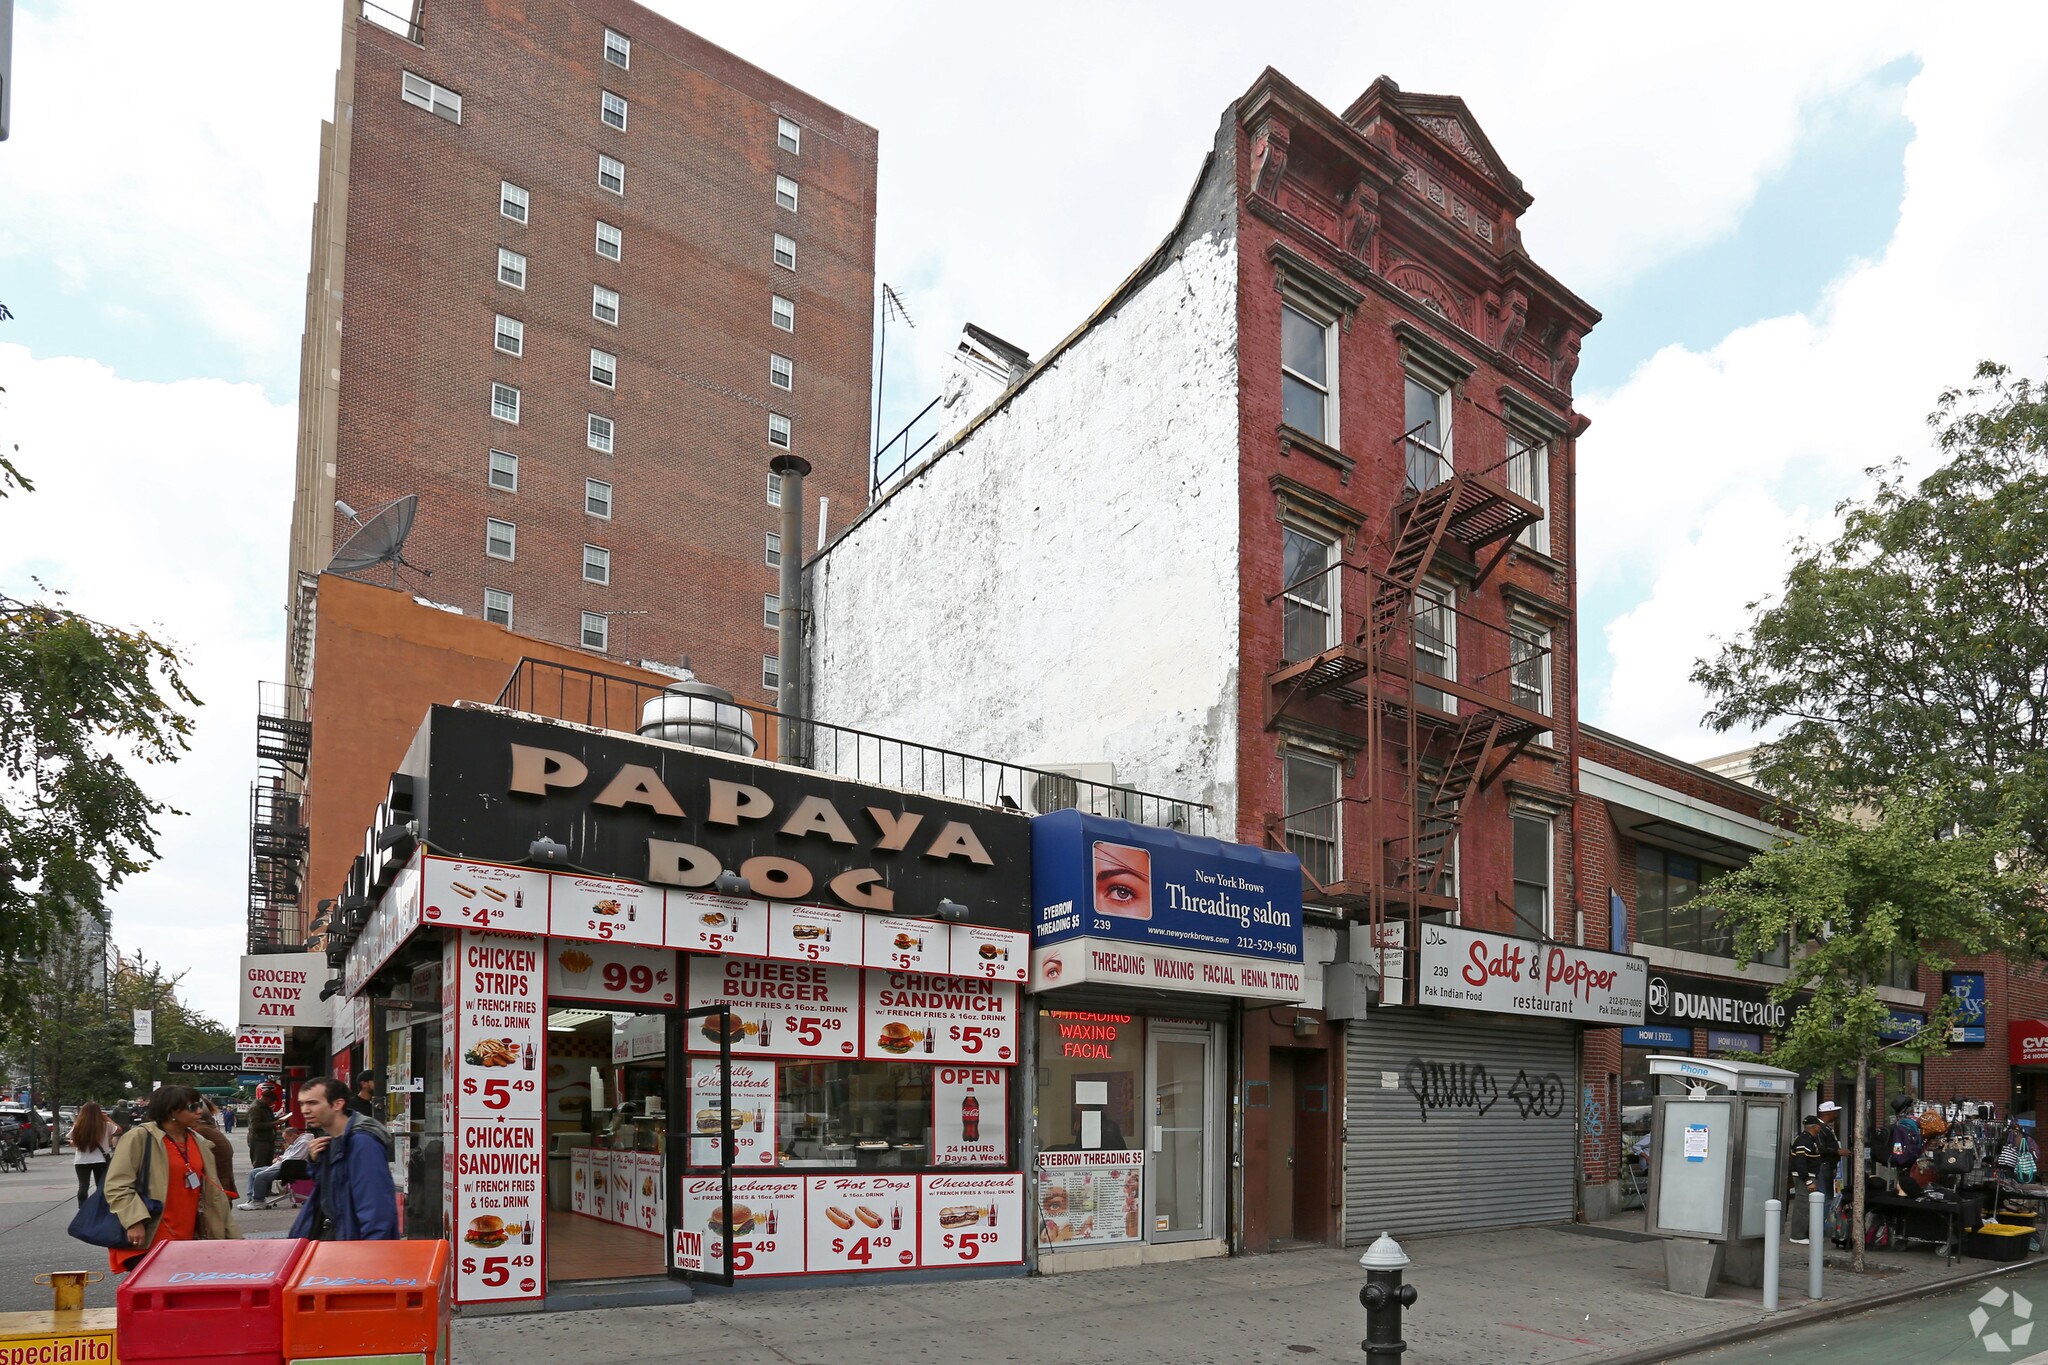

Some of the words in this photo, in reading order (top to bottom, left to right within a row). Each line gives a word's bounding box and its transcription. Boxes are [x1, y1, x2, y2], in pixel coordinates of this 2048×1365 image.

[509, 743, 994, 865] PAPAYA
[467, 866, 489, 875] Hot
[494, 869, 521, 880] Dogs
[647, 838, 894, 911] DOG
[575, 879, 613, 890] Chicken
[616, 884, 645, 894] Strips
[1195, 870, 1215, 884] New
[1217, 871, 1237, 888] York
[1238, 876, 1264, 894] Brows
[686, 893, 704, 901] Fish
[708, 895, 749, 906] Sandwich
[1165, 882, 1250, 930] Threading
[1253, 901, 1291, 928] salon
[793, 907, 842, 918] Cheesesteak
[1044, 900, 1072, 920] EYEBROW
[880, 919, 904, 927] Chicken
[906, 922, 934, 930] Sandwich
[1037, 917, 1070, 936] THREADING
[1072, 914, 1080, 929] $5
[1094, 919, 1111, 930] 239
[969, 929, 1014, 940] Cheeseburger
[1147, 926, 1229, 944] www.newyorkbrows.com
[1425, 928, 1447, 946] حلال
[1237, 936, 1297, 955] 212-529-9500
[468, 946, 535, 972] CHICKEN
[725, 960, 827, 984] CHEESE
[1092, 951, 1145, 976] THREADING
[1154, 958, 1194, 981] WAXING
[1203, 964, 1235, 985] FACIAL
[1241, 969, 1268, 989] HENNA
[1271, 972, 1299, 992] TATTOO
[1434, 966, 1449, 977] 239
[1462, 940, 1525, 986] Salt
[1529, 955, 1540, 980] &
[1546, 948, 1618, 1003] Pepper
[1626, 962, 1643, 972] HALAL
[248, 969, 307, 984] GROCERY
[475, 972, 528, 996] STRIPS
[723, 979, 829, 1002] BURGER
[890, 974, 993, 995] CHICKEN
[252, 986, 301, 1000] CANDY
[1425, 985, 1438, 996] Pak
[1440, 987, 1463, 999] Indian
[1466, 990, 1482, 1001] Food
[477, 999, 510, 1012] FRENCH
[513, 1001, 536, 1013] FRIES
[714, 999, 753, 1008] FRENCH
[755, 1002, 782, 1010] FRIES
[794, 1004, 818, 1012] 16oz.
[820, 1005, 848, 1013] DRINK
[880, 990, 1002, 1012] SANDWICH
[1513, 996, 1573, 1013] restaurant
[1609, 997, 1642, 1007] 212-677-0005
[258, 1003, 295, 1016] ATM
[887, 1009, 922, 1018] FRENCH
[924, 1011, 947, 1019] FRIES
[1599, 1005, 1608, 1014] Pak
[1611, 1007, 1627, 1016] Indian
[1629, 1009, 1641, 1017] Food
[472, 1015, 478, 1026] &
[481, 1015, 502, 1028] 16oz.
[505, 1016, 530, 1029] DRINK
[1059, 1024, 1117, 1041] WAXING
[1639, 1031, 1654, 1040] HOW
[1659, 1033, 1673, 1042] FEEL
[237, 1036, 282, 1044] ATM
[1718, 1037, 1730, 1045] HOW
[1064, 1043, 1112, 1059] FACIAL
[1681, 1064, 1708, 1075] Phone
[940, 1069, 1000, 1085] OPEN
[466, 1127, 534, 1149] CHICKEN
[961, 1145, 995, 1153] HOURS
[459, 1153, 539, 1174] SANDWICH
[945, 1154, 968, 1162] Days
[1040, 1154, 1082, 1166] EYEBROW
[1084, 1153, 1130, 1164] THREADING
[476, 1181, 509, 1192] FRENCH
[512, 1180, 535, 1192] FRIES
[814, 1180, 827, 1190] 2
[833, 1178, 866, 1190] Hot
[872, 1178, 911, 1192] Dogs
[929, 1177, 1015, 1190] Cheesesteak
[470, 1197, 477, 1208] &
[480, 1197, 500, 1208] 16oz.
[503, 1196, 529, 1207] DRINK
[676, 1232, 701, 1256] ATM
[678, 1257, 700, 1269] INSIDE
[0, 1339, 109, 1365] specialito
